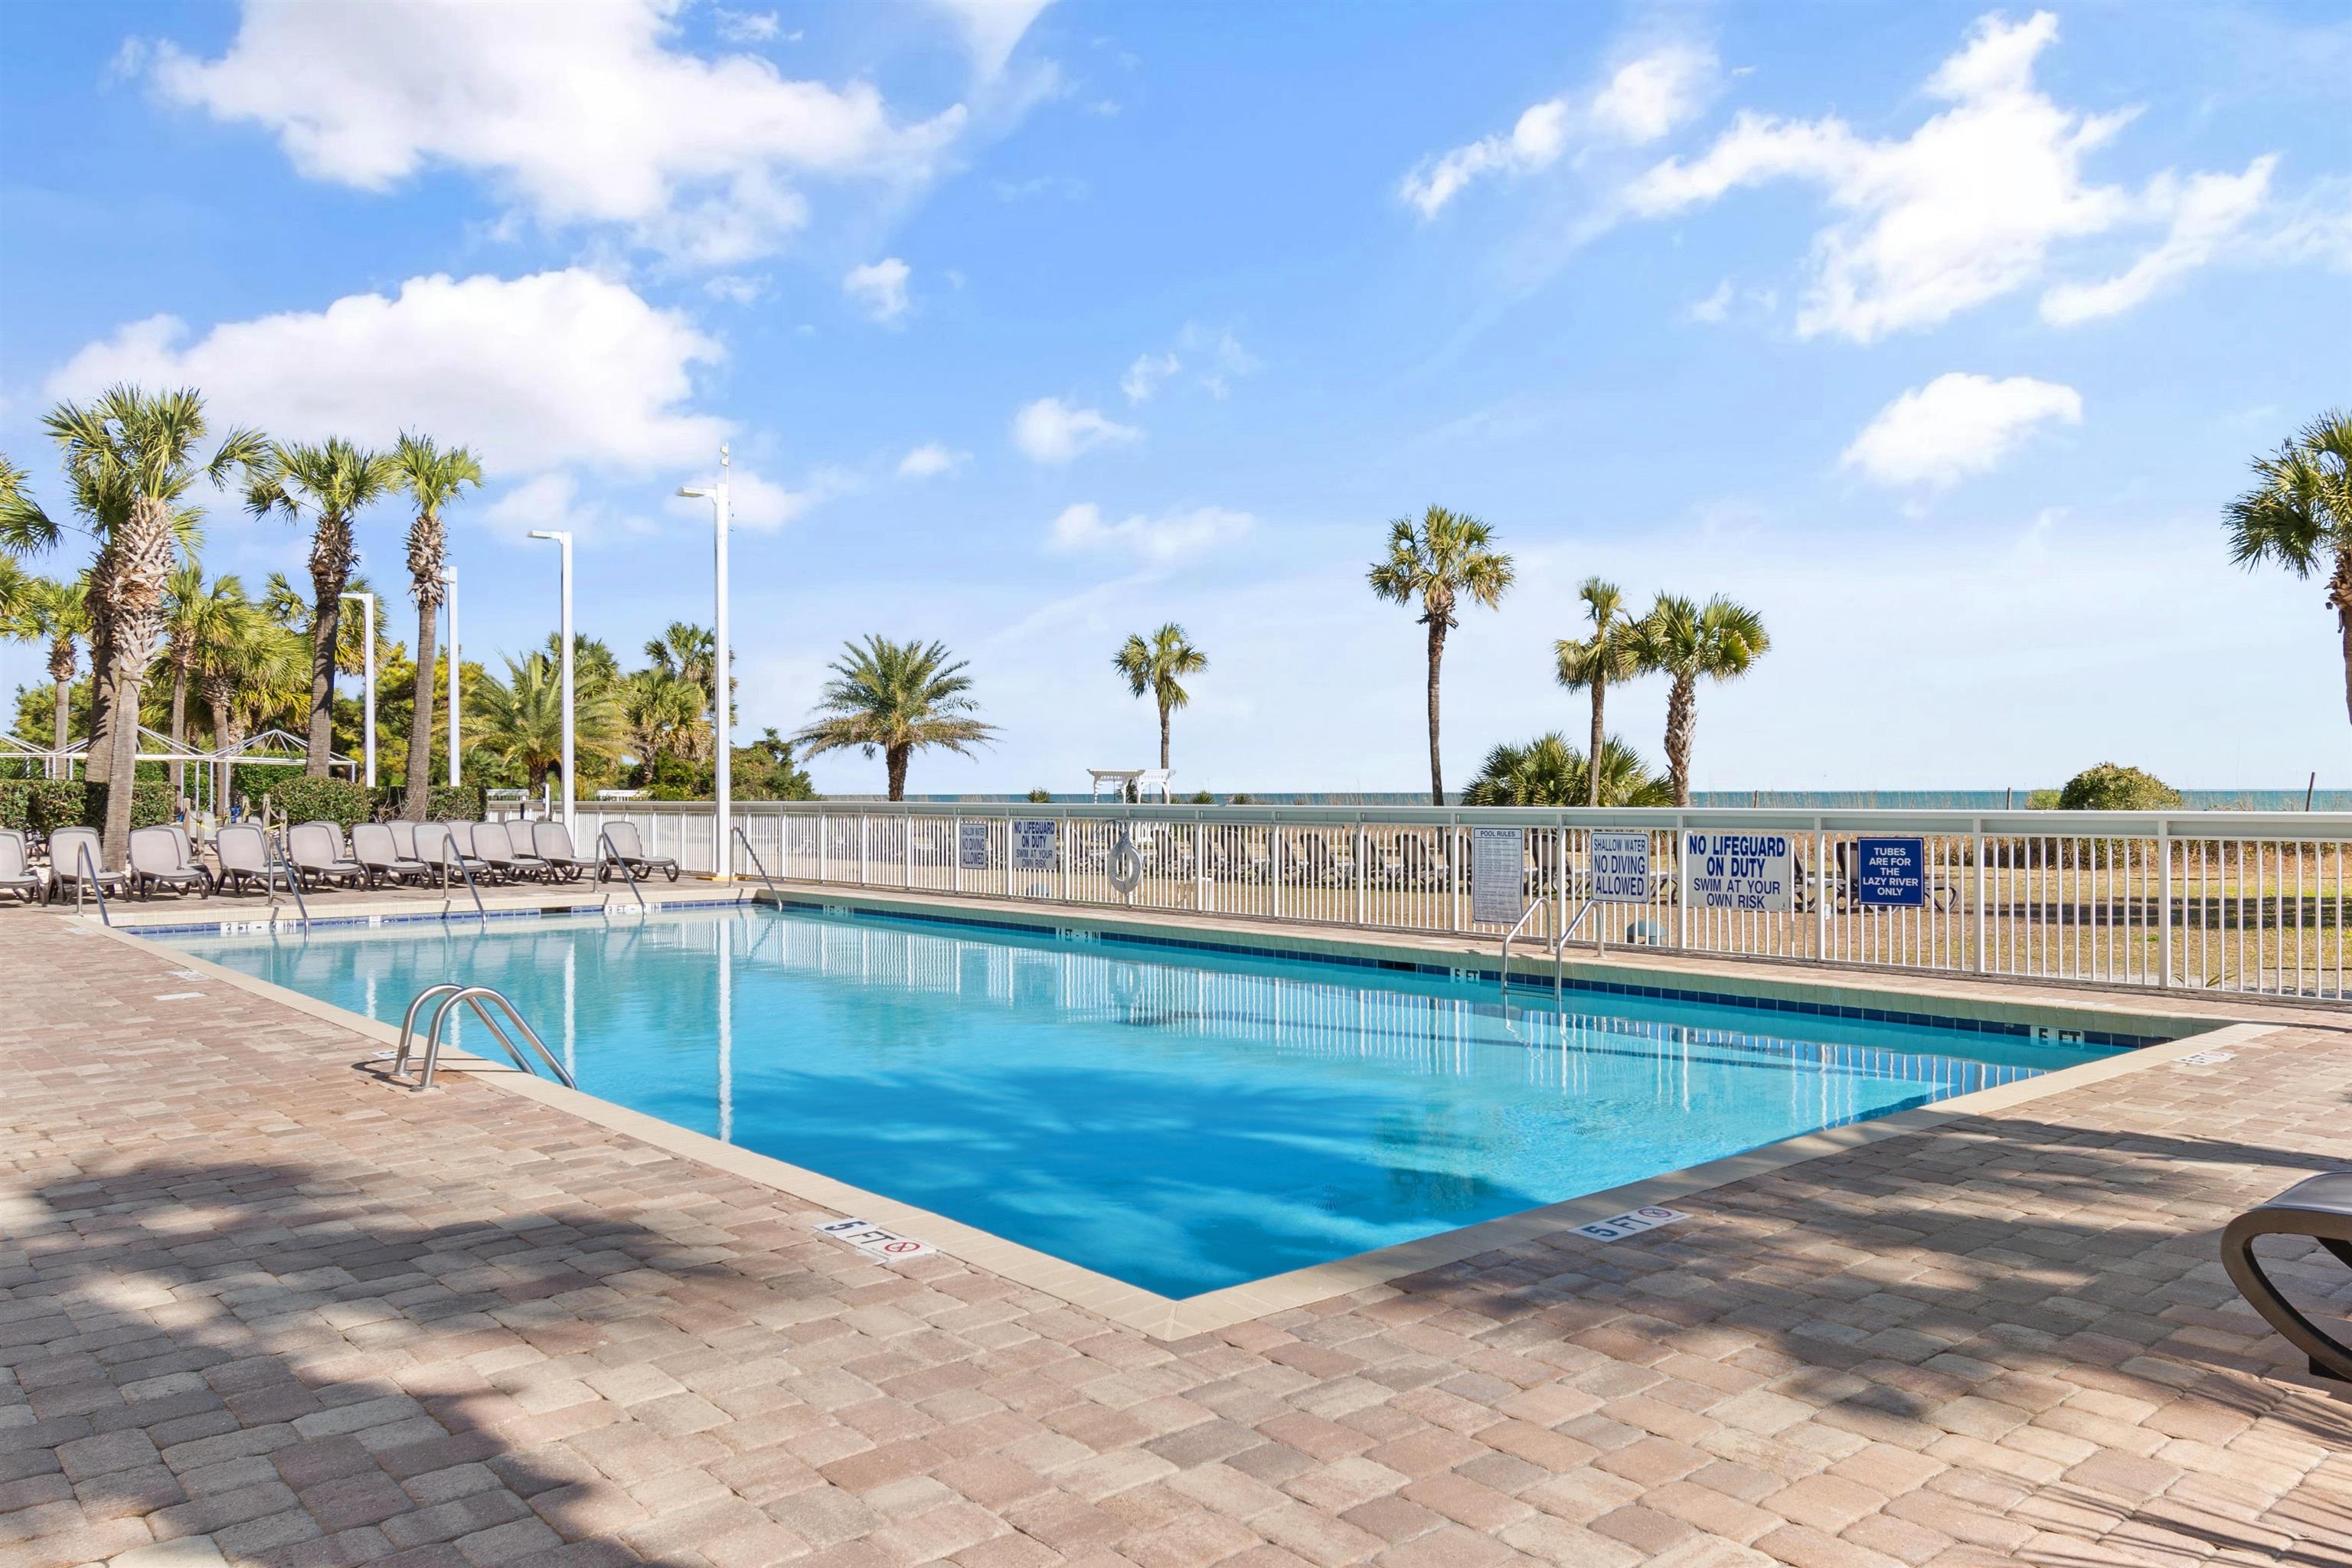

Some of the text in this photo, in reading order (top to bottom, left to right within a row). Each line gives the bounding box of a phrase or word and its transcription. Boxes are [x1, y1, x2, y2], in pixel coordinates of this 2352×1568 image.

[1014, 822, 1054, 835] NO LIFEGUARD
[1022, 835, 1047, 848] ON DUTY
[1594, 839, 1645, 852] SHALLOW WATER
[1690, 835, 1785, 857] NO LIFEGUARD
[963, 851, 984, 864] ALLOWED
[1016, 849, 1028, 858] SWIM
[1038, 850, 1053, 858] YOUR
[1873, 848, 1906, 856] TUBES
[1022, 858, 1047, 868] OWN RISK
[1595, 854, 1645, 874] NO DIVING
[1707, 856, 1766, 877] ON DUTY
[1890, 858, 1911, 866] FOR
[1880, 867, 1900, 876] THE
[1596, 876, 1644, 896] ALLOWED
[1694, 878, 1780, 894] SWIM AT YOUR
[1877, 887, 1903, 896] ONLY
[1707, 893, 1765, 909] OWN RISK
[1466, 969, 1478, 981] FT
[2058, 1030, 2081, 1044] FT
[825, 1220, 897, 1244] 5 FT
[1581, 1226, 1619, 1236] 5
[1606, 1216, 1651, 1230] FT
